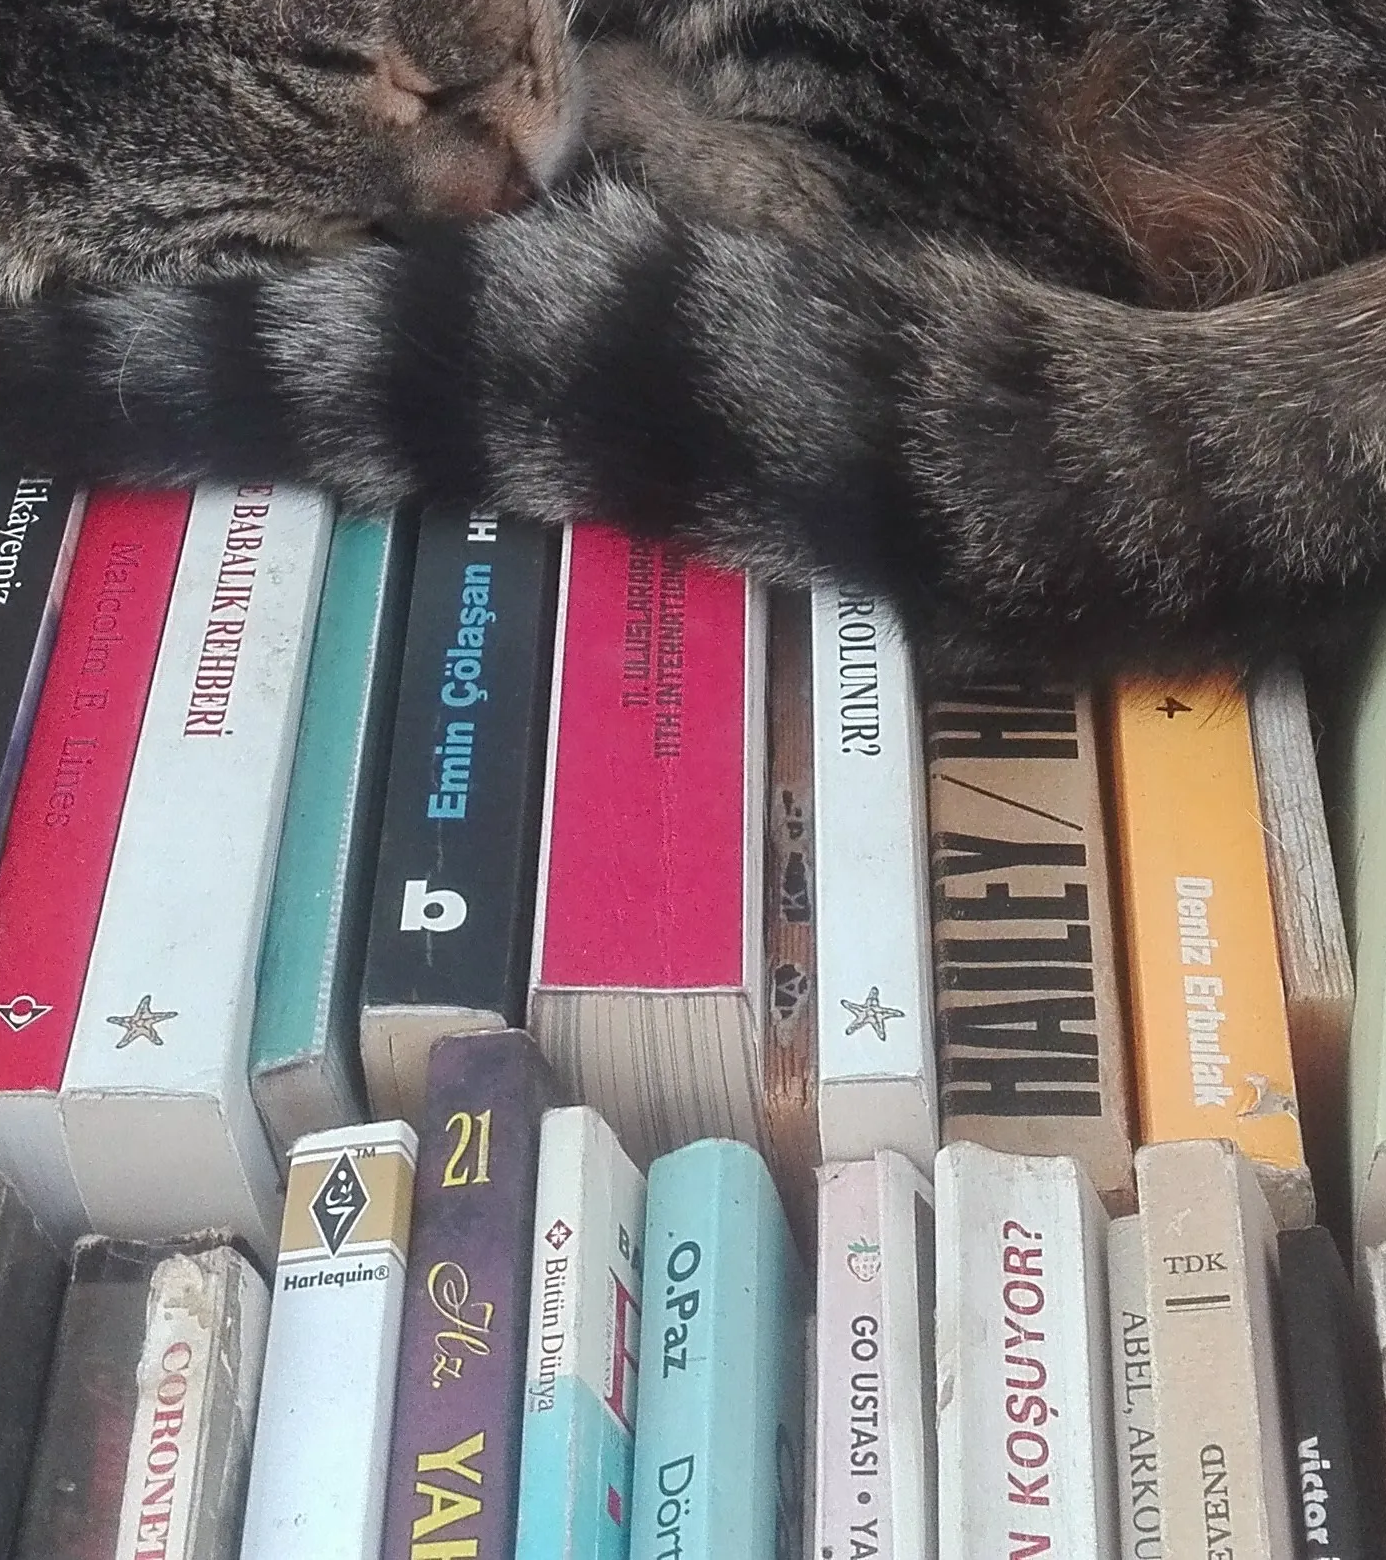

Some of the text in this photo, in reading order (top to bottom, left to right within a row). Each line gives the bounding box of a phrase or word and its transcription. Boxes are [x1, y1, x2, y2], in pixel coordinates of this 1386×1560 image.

[214, 501, 271, 612] BABALIK
[184, 618, 247, 738] REHBERİ
[427, 561, 500, 821] Emin Çölaşan
[938, 829, 1103, 1119] HAILEY
[1173, 875, 1234, 1109] Deniz Erbulak
[441, 1108, 494, 1189] 21
[1163, 1252, 1229, 1275] TDK
[536, 1255, 570, 1415] Bütün Dünya
[849, 1314, 879, 1477] GO USTASI
[1002, 1218, 1060, 1507] KOŞUYOR?
[1121, 1310, 1152, 1415] ABEL,
[1297, 1435, 1327, 1546] victor
